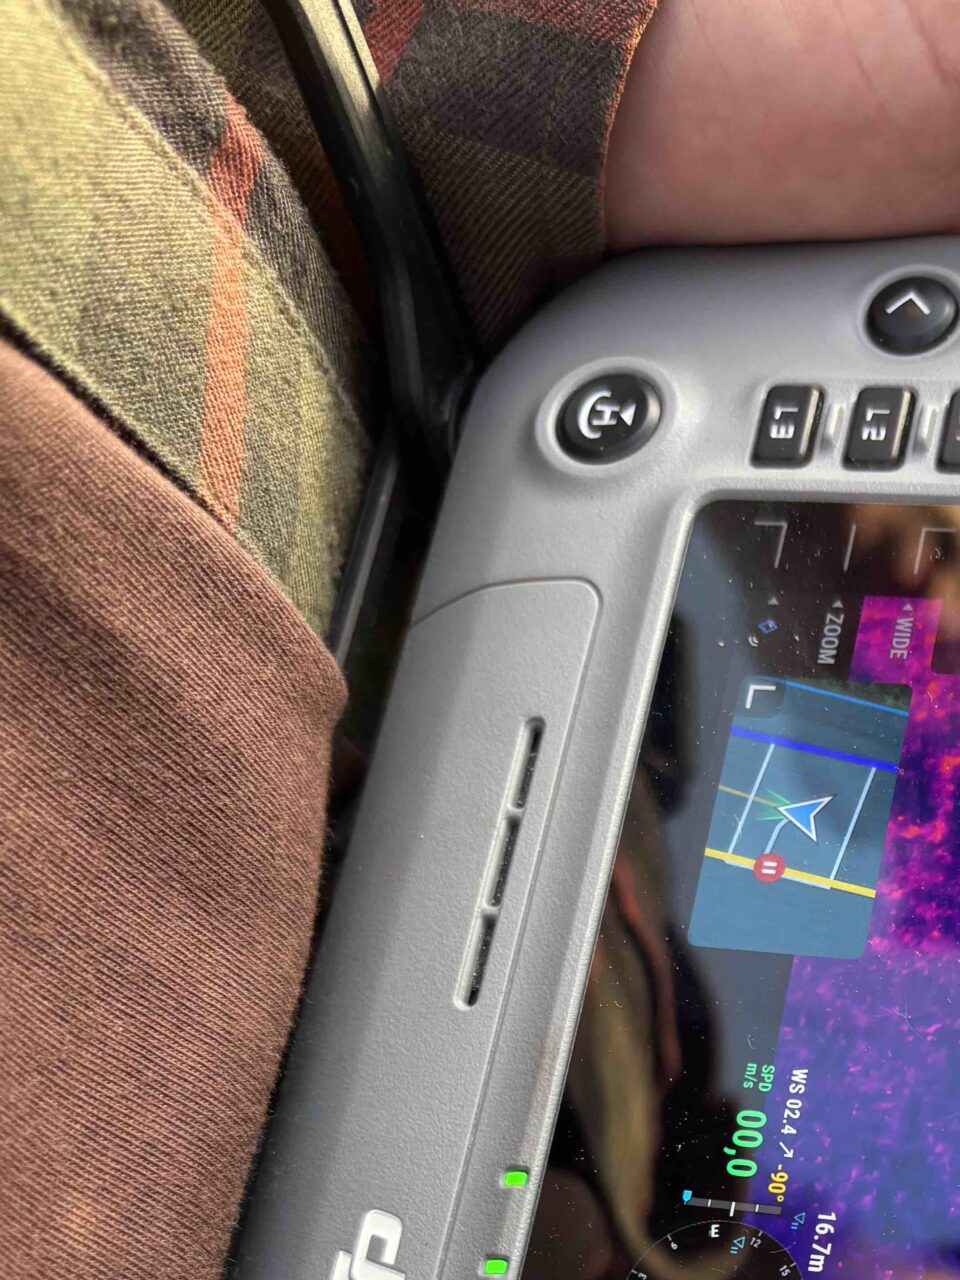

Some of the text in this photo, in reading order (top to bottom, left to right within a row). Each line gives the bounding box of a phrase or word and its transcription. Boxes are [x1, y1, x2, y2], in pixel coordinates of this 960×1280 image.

[770, 406, 799, 439] L3
[861, 408, 890, 441] L2
[816, 614, 844, 665] ZOOM
[889, 618, 914, 660] WIDE
[742, 1062, 758, 1089] m/s
[758, 1064, 775, 1092] SPD
[780, 1068, 808, 1135] WS 02.4
[722, 1110, 768, 1178] 00,0
[768, 1164, 788, 1202] -90°
[708, 1224, 720, 1238] E
[750, 1237, 762, 1248] 12
[808, 1212, 837, 1272] 16.7m
[778, 1264, 790, 1277] 15
